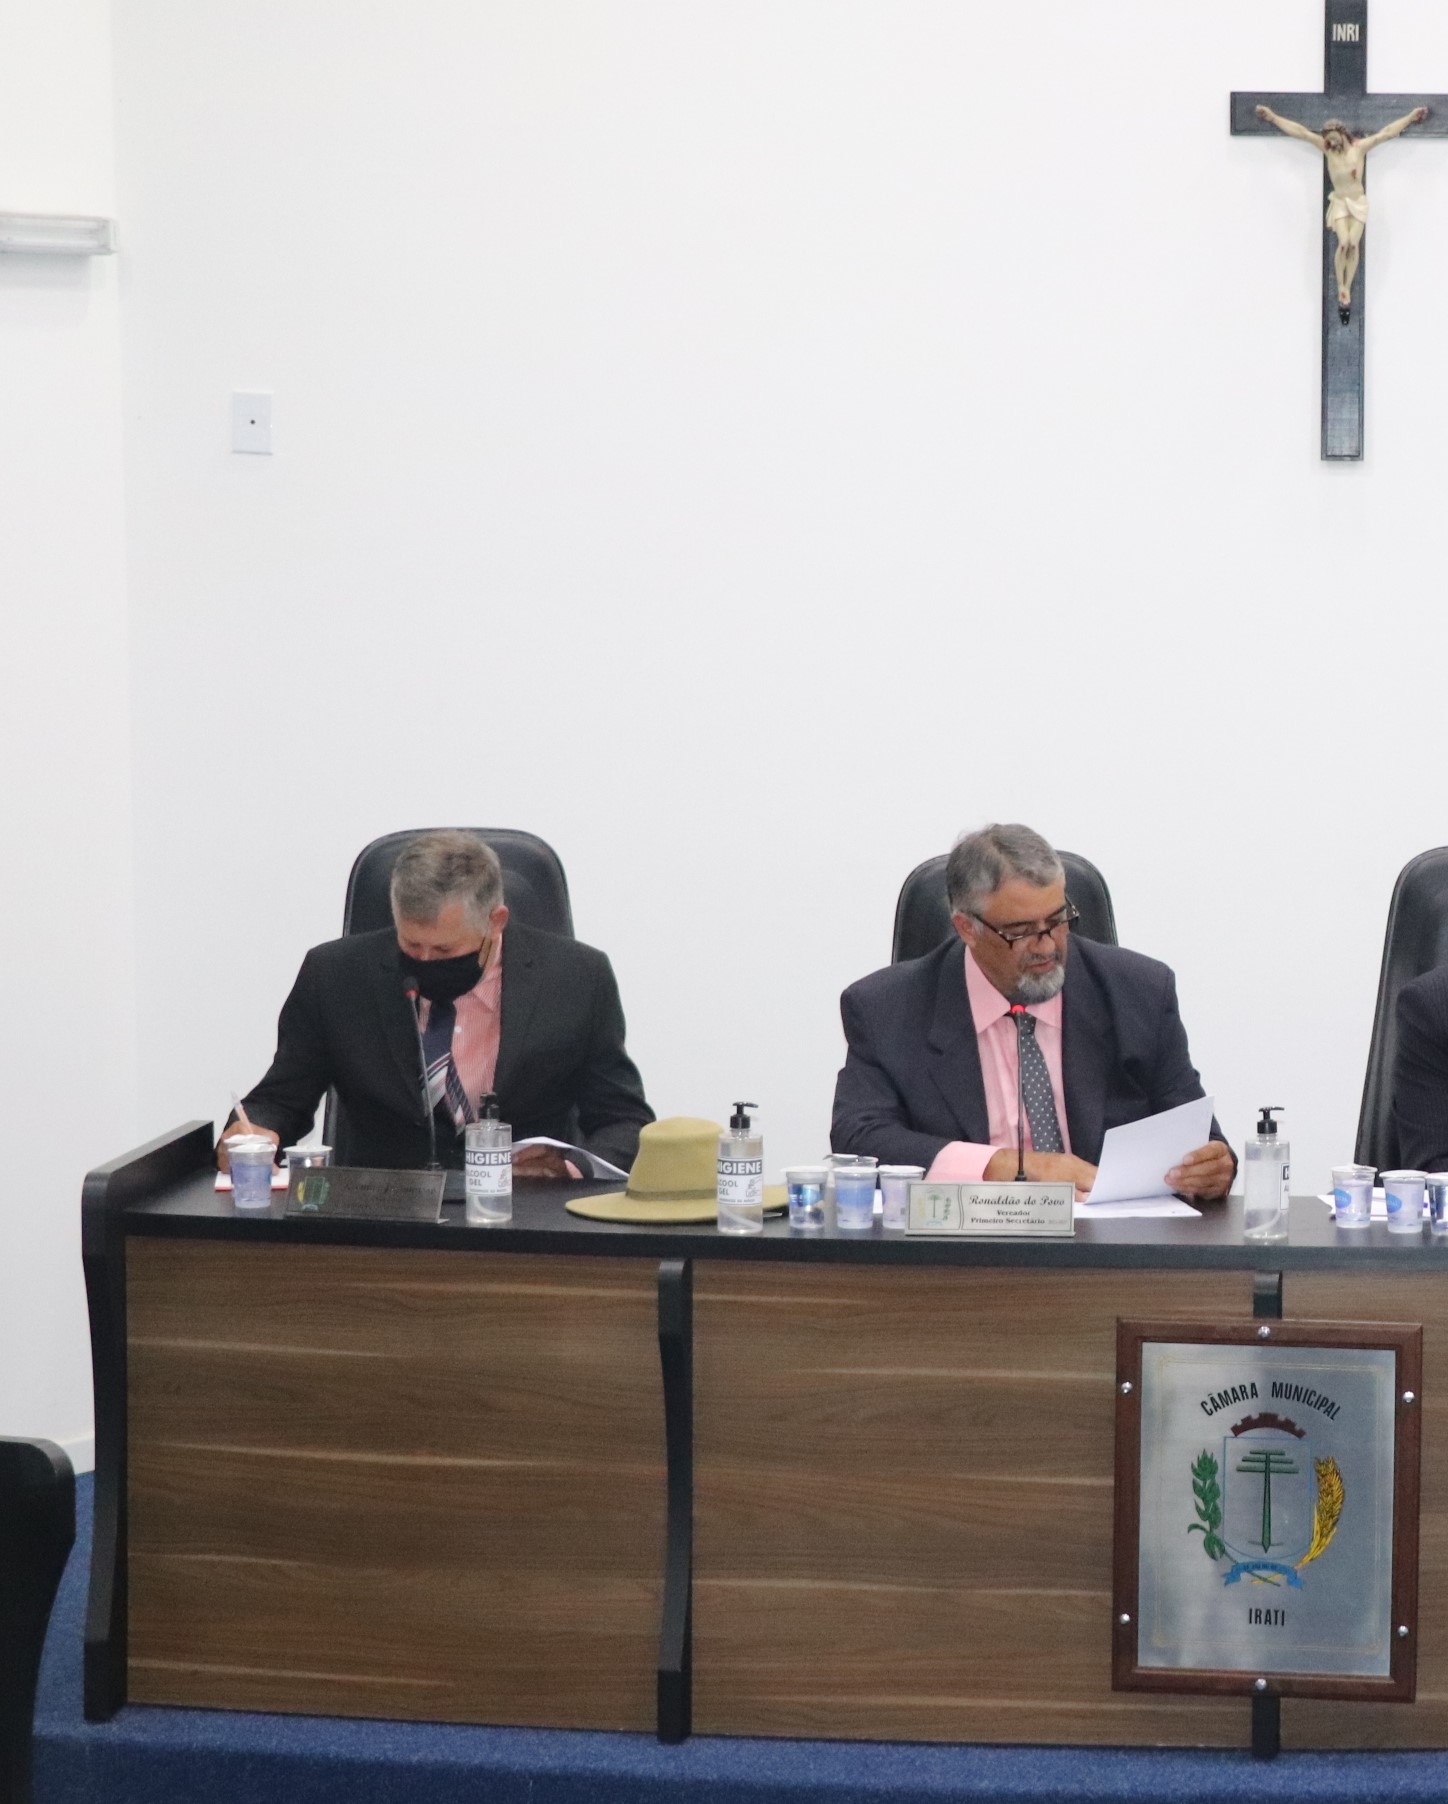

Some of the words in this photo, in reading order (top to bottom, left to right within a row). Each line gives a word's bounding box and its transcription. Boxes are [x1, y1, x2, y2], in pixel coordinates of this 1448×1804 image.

[1332, 23, 1360, 42] INRI
[465, 1151, 512, 1165] HIGIENE
[1200, 1382, 1259, 1417] CÂMARA
[1271, 1381, 1342, 1421] MUNICIPAL
[1248, 1607, 1286, 1627] IRATI
